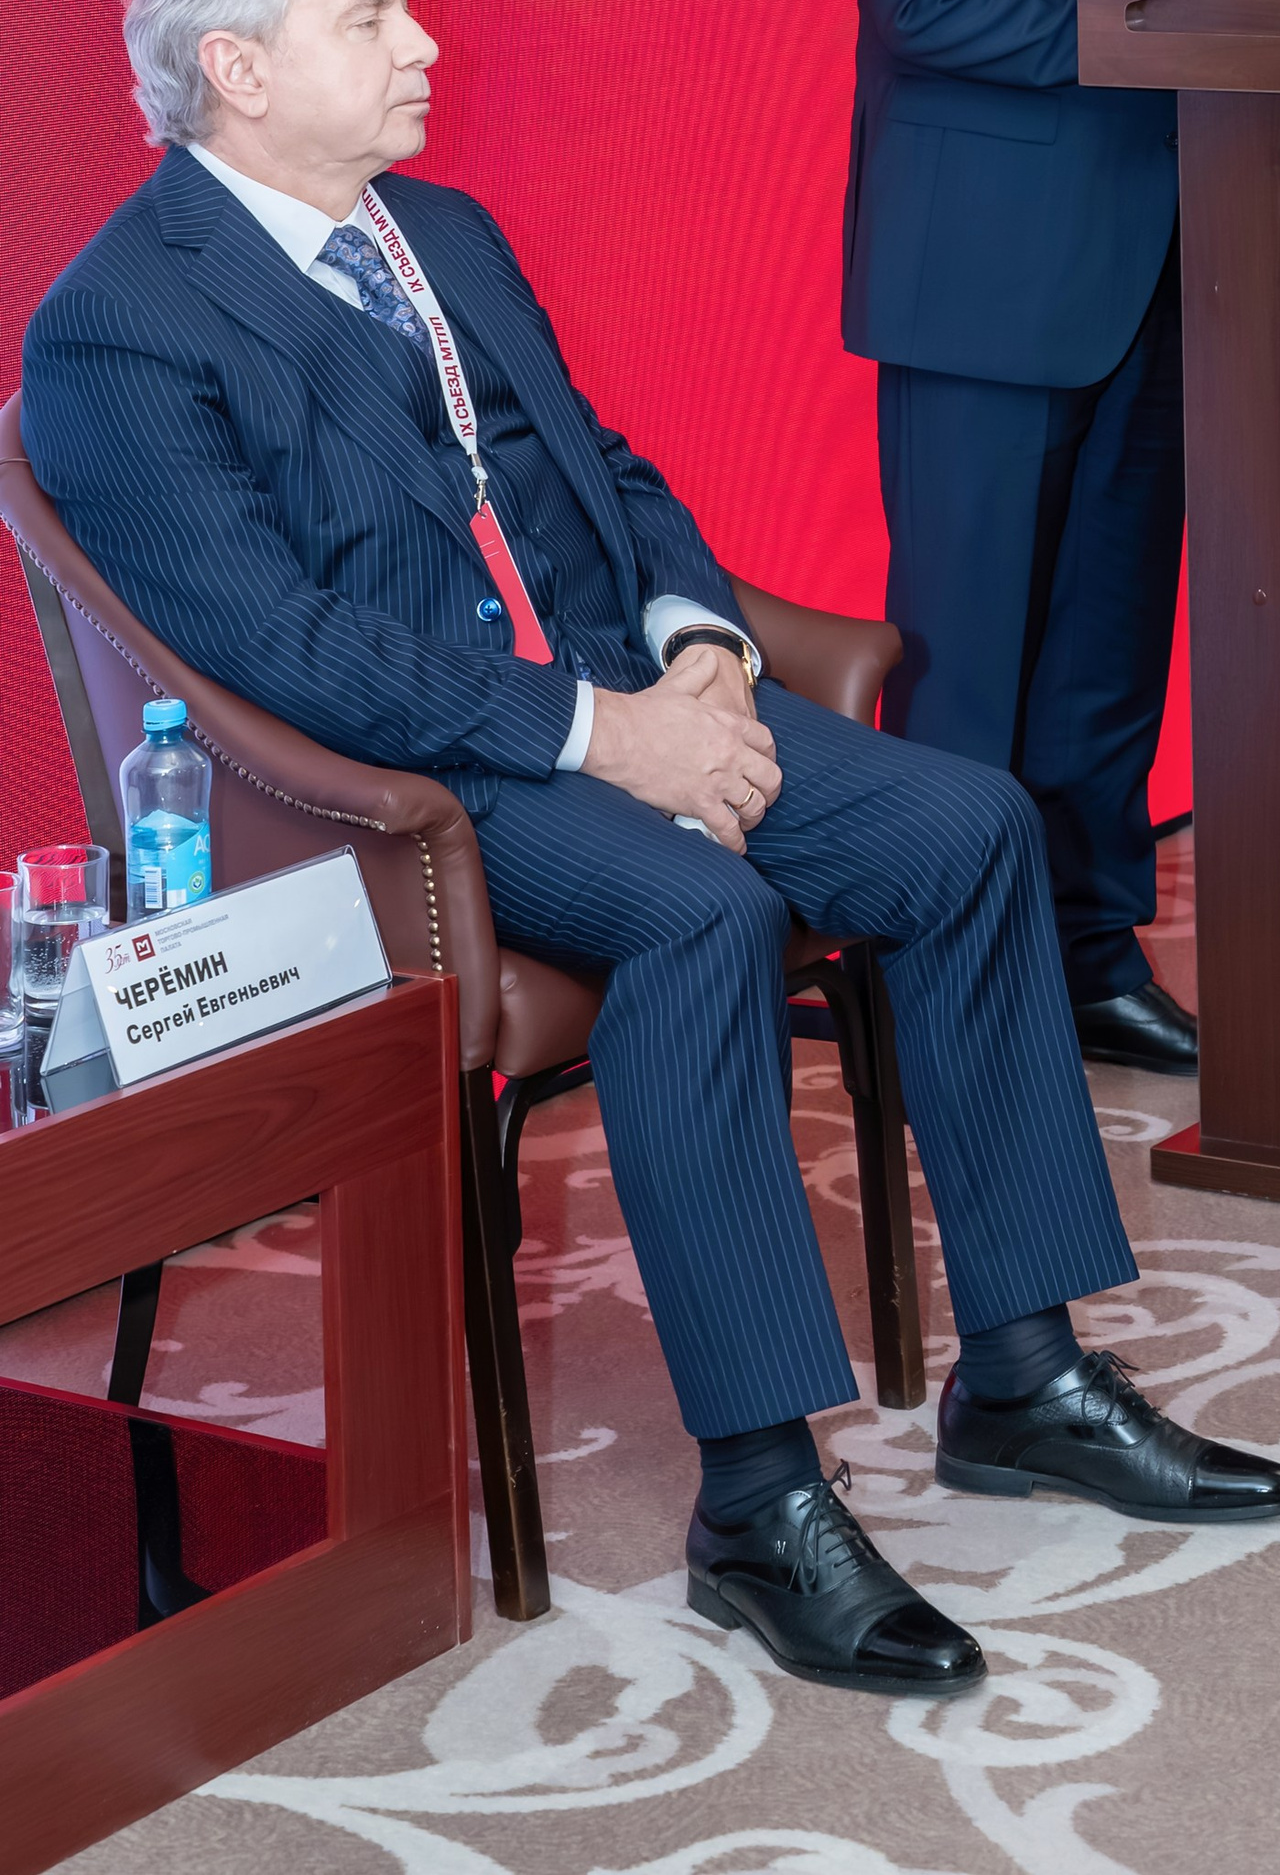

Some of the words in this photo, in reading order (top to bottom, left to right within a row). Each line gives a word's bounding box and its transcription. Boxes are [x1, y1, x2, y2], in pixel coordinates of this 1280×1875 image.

[382, 228, 415, 278] СЪЕЗД
[407, 278, 425, 293] IX
[429, 317, 453, 361] МТПП
[444, 365, 469, 419] СЪЕЗД
[459, 422, 475, 437] IX
[154, 918, 193, 936] МОСКОВСКАЯ
[157, 914, 229, 944] ТОРГОВО-ПРОМЫШЛЕННАЯ
[160, 941, 182, 954] ПАЛАТА
[114, 951, 229, 1010] ЧЕРЁМИН
[126, 1003, 196, 1043] Сергей
[196, 966, 301, 1019] Евгеньевич
